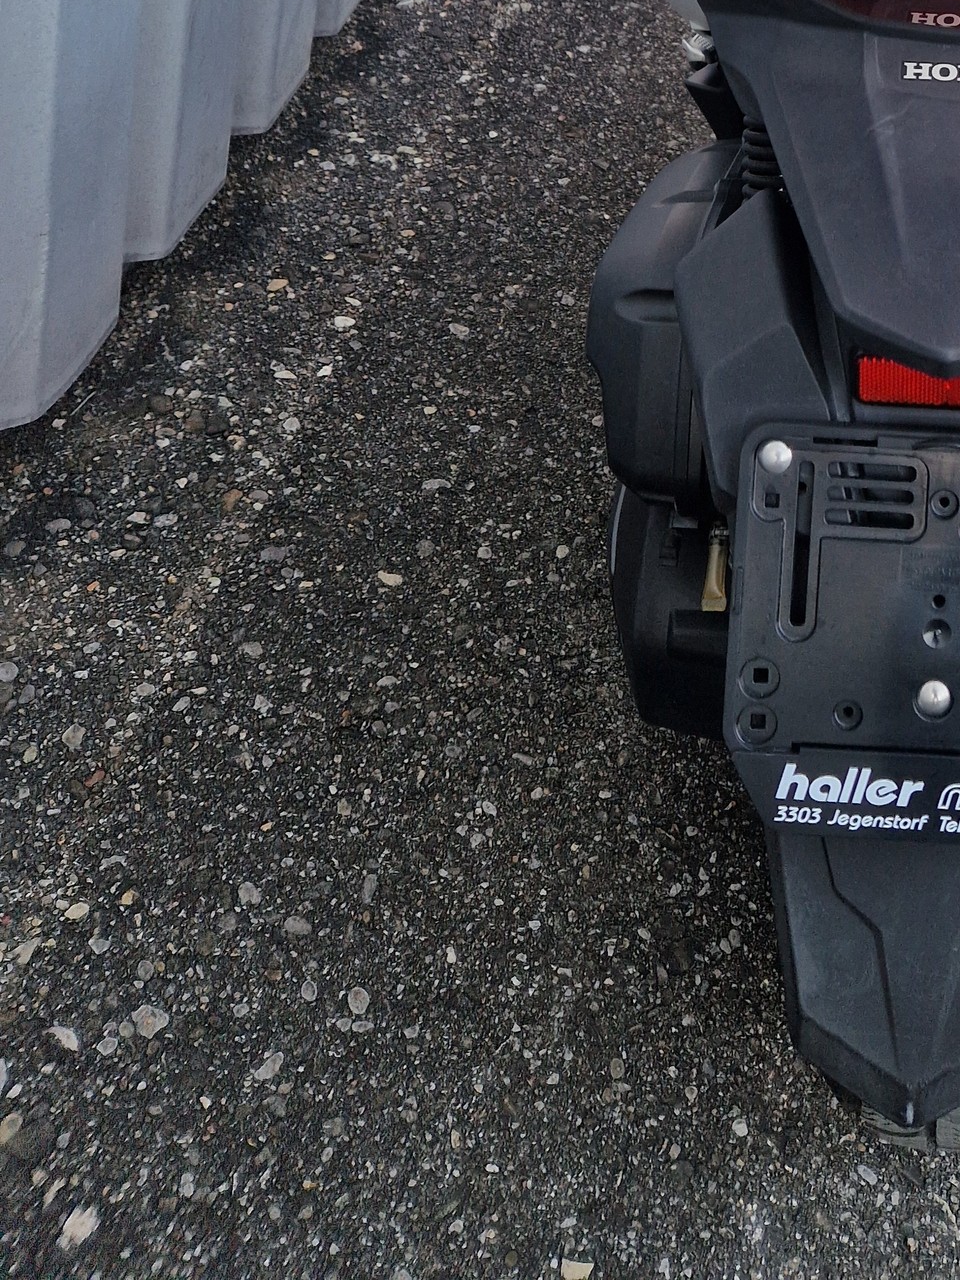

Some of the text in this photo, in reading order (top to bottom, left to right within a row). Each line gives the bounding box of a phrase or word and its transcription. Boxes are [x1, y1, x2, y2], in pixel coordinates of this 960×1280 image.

[775, 762, 925, 807] haller
[773, 805, 822, 824] 3303
[826, 809, 930, 831] Jegenstorf
